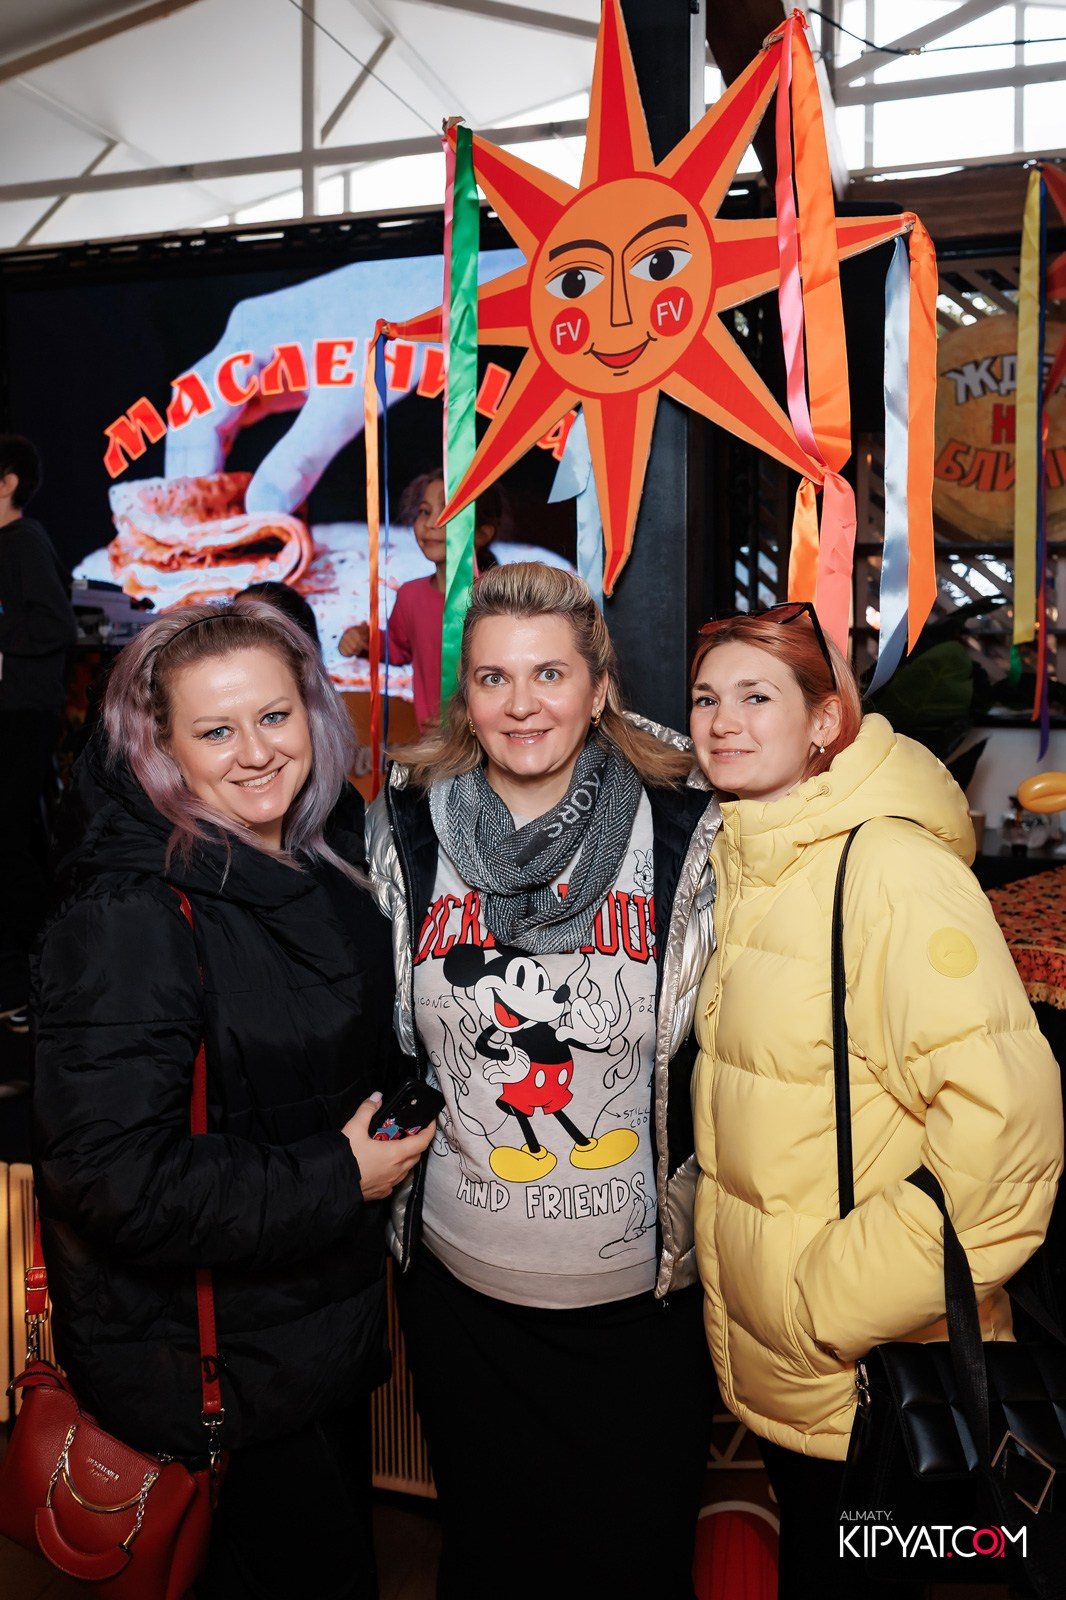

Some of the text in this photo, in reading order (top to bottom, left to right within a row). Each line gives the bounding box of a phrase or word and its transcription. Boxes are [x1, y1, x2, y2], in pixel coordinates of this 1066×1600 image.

[655, 297, 684, 327] FV
[555, 318, 582, 346] FV
[630, 1116, 648, 1128] COO
[456, 1171, 645, 1219] AND FRIENDS
